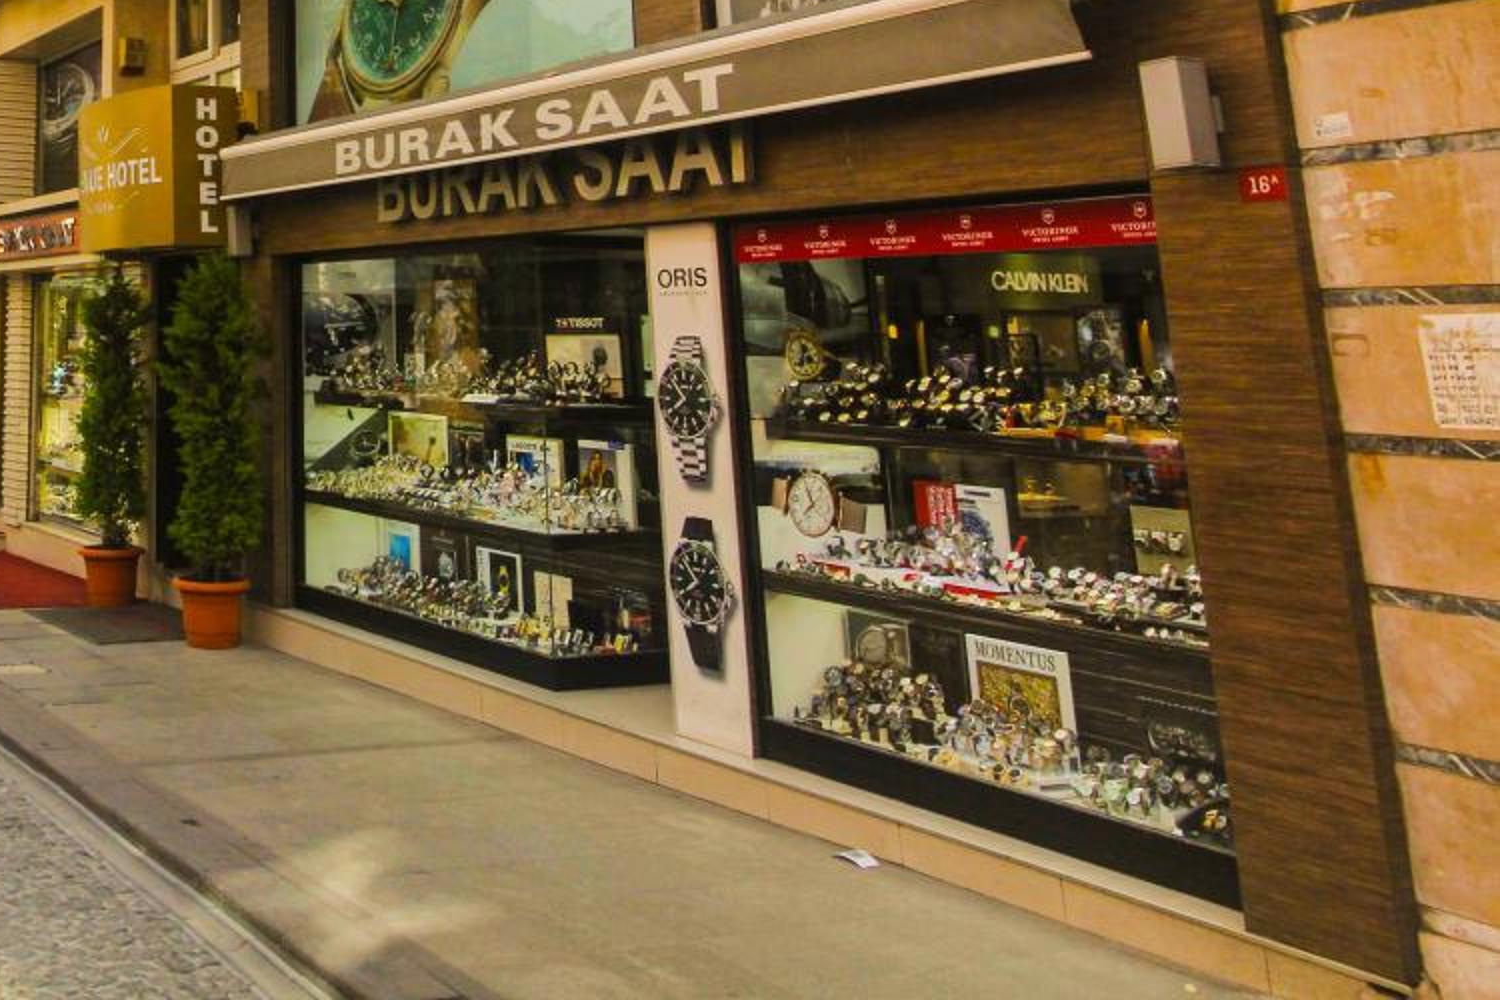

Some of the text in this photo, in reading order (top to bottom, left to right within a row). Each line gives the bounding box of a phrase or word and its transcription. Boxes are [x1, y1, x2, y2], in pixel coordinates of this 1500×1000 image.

[335, 63, 733, 176] BURAK SAAT
[106, 156, 163, 190] HOTEL
[195, 96, 219, 233] HOTEL
[657, 267, 707, 288] ORIS
[974, 641, 1056, 672] MOMENTUS
